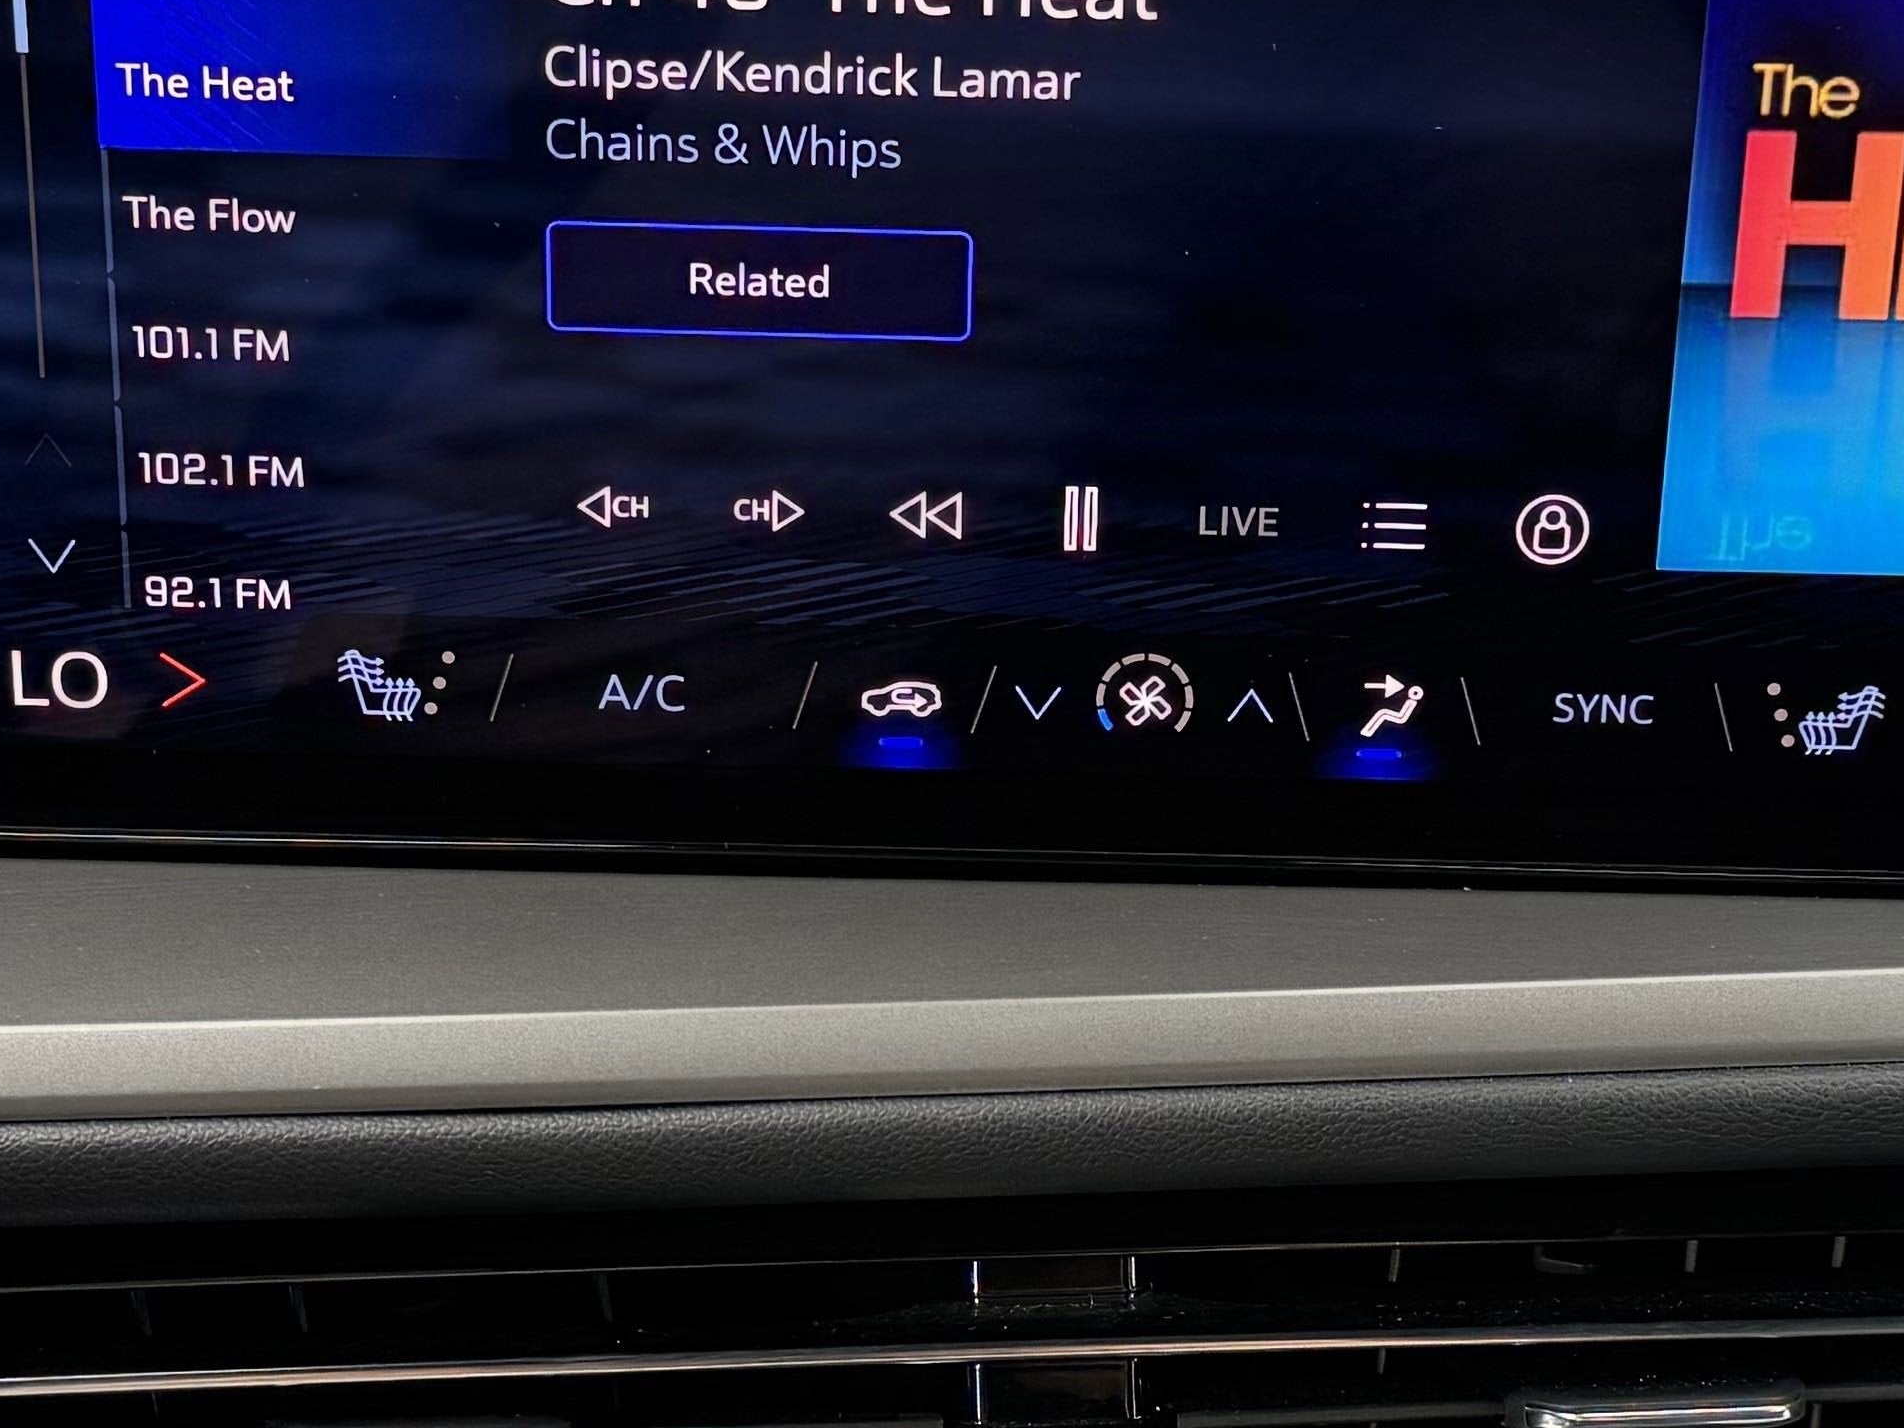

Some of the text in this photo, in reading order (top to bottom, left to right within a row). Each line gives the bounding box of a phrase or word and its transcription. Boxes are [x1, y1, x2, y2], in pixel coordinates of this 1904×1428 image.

[114, 61, 295, 102] The Heat
[544, 43, 1082, 101] Clipse/Kendrick Lamar
[1752, 62, 1861, 119] The
[546, 117, 902, 179] Chains & Whips
[121, 194, 296, 234] The Flow
[689, 261, 830, 298] Related
[132, 325, 290, 362] 101.1 FM
[138, 451, 305, 488] 102.1 FM
[612, 495, 649, 519] CH
[733, 498, 769, 522] CH
[1199, 505, 1280, 537] LIVE
[144, 575, 291, 610] 92.1 FM
[11, 649, 108, 709] LO
[598, 673, 686, 712] A/C
[1552, 692, 1654, 725] SYNC
